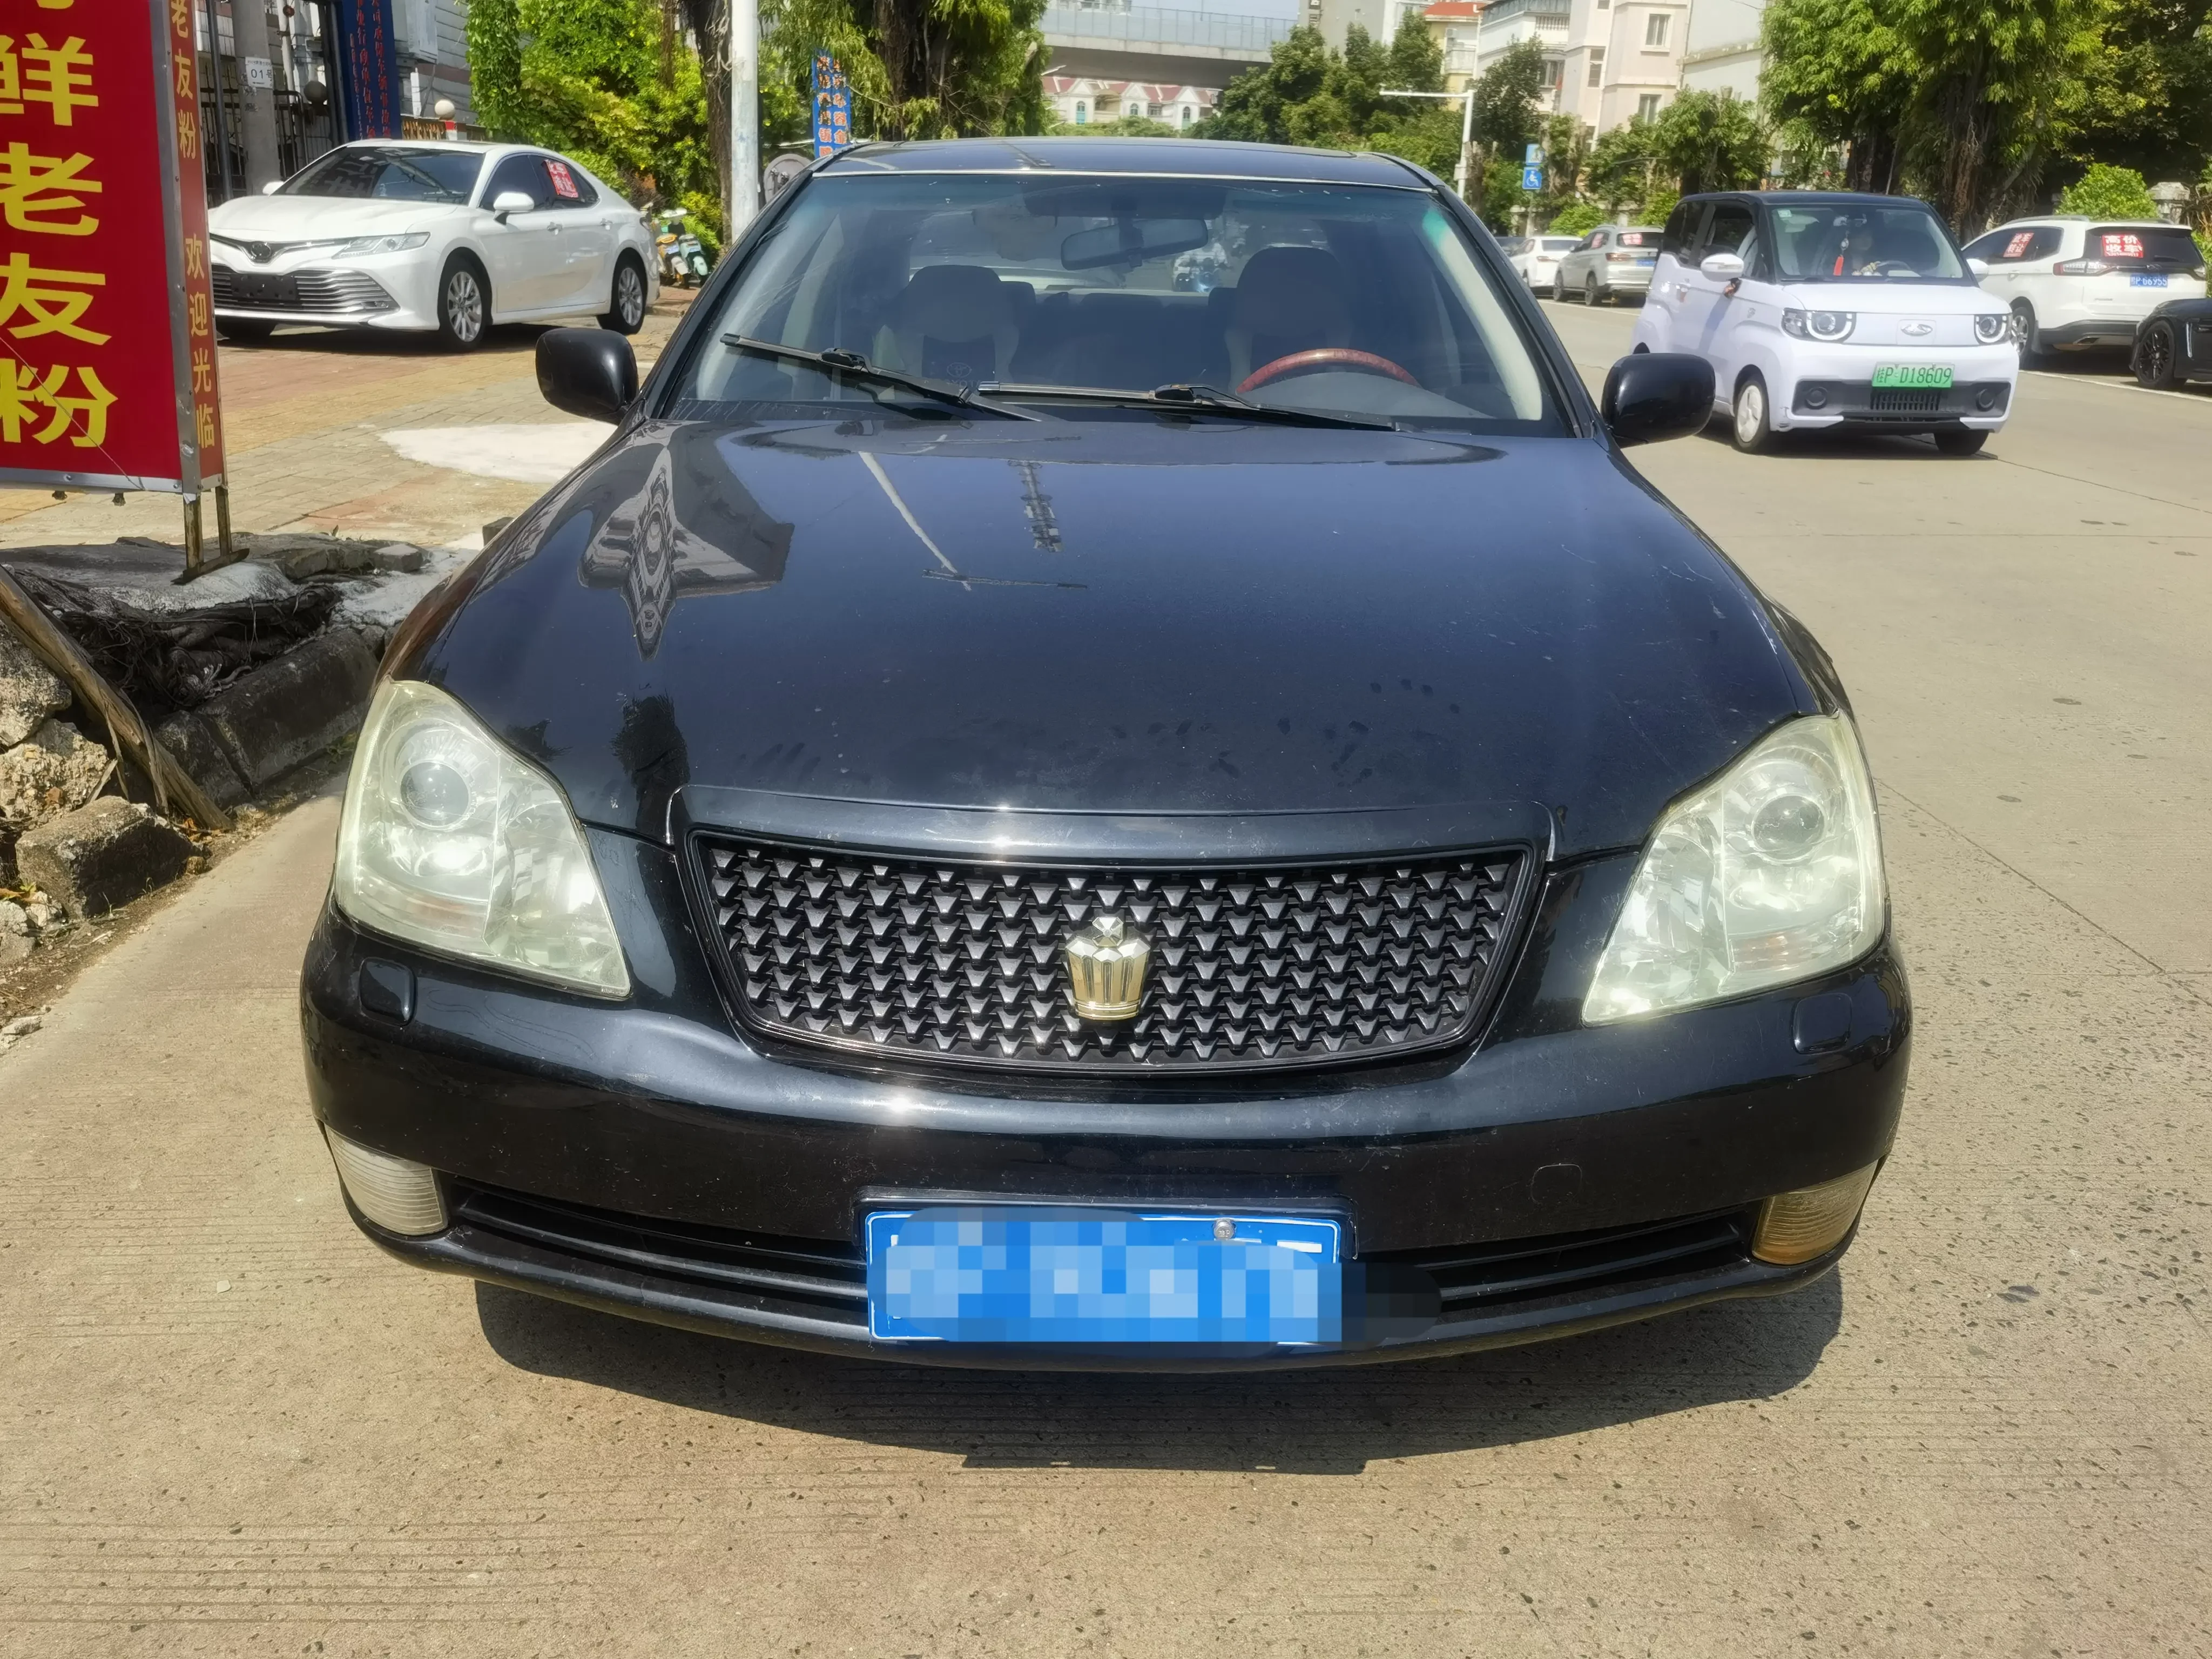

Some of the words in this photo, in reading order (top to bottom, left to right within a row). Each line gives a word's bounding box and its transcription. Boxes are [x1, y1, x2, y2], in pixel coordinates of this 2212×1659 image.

[171, 0, 196, 159] 老友粉
[0, 0, 118, 448] 鲜老友粉
[185, 233, 215, 448] 欢迎光临
